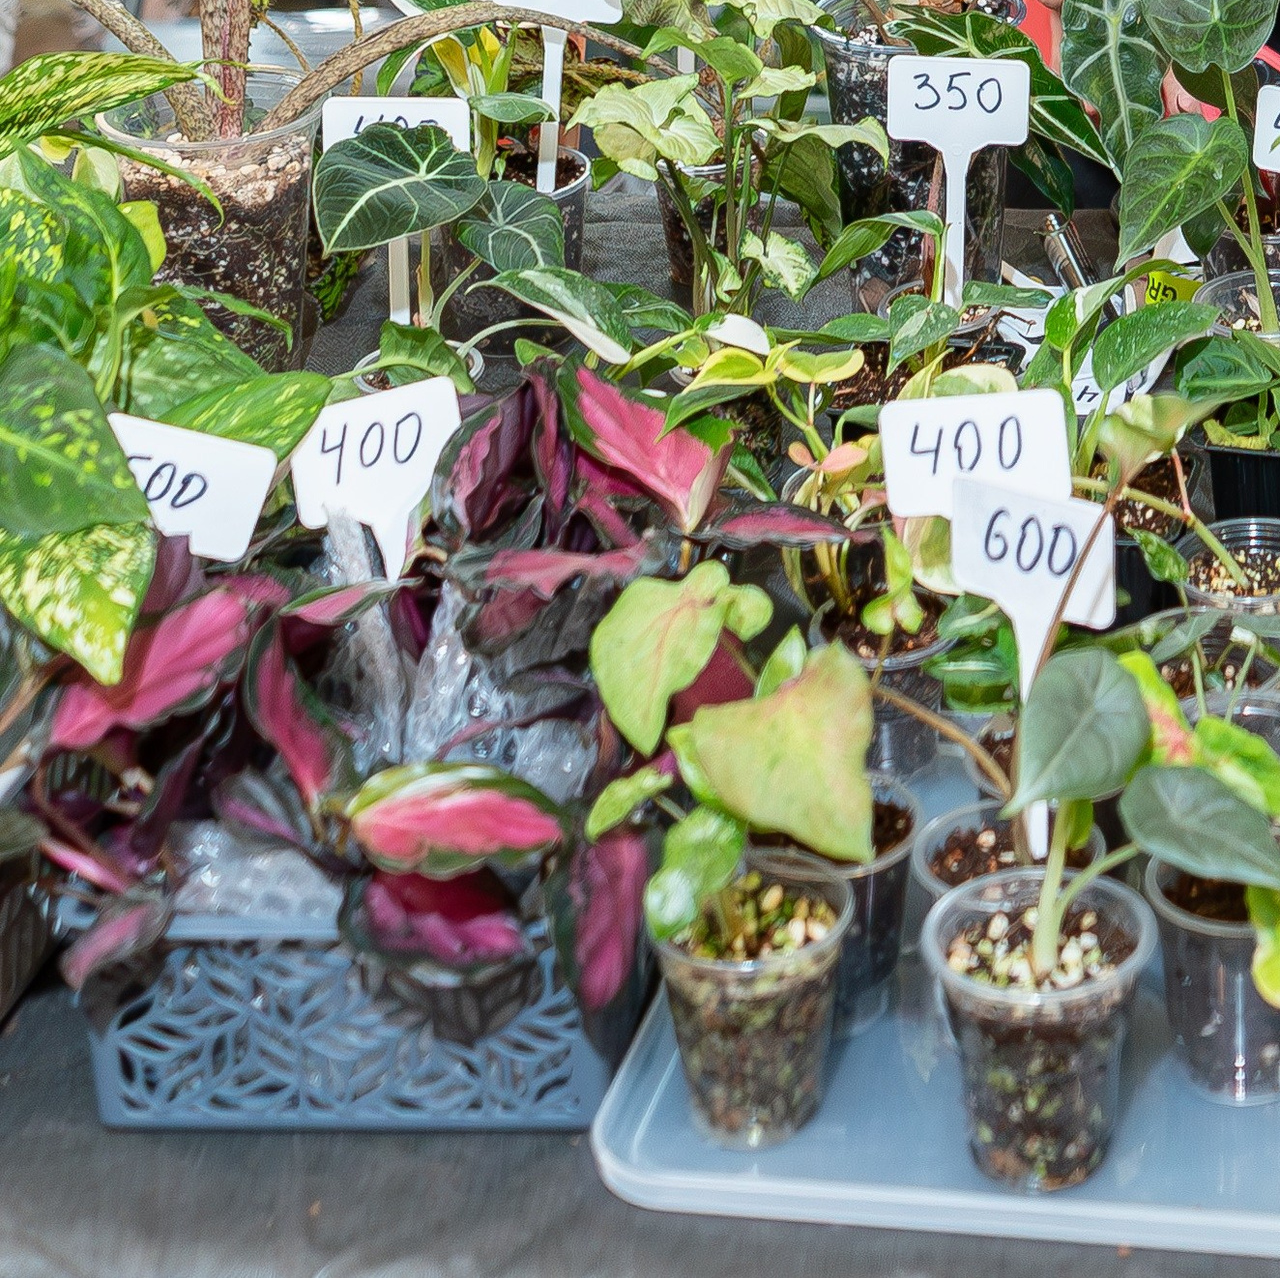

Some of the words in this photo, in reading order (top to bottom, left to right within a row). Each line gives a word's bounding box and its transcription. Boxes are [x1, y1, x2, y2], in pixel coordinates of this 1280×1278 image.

[913, 71, 1003, 114] 350
[320, 412, 423, 486] 400
[910, 415, 1023, 476] 400
[128, 455, 207, 510] 00
[984, 507, 1077, 576] 600
